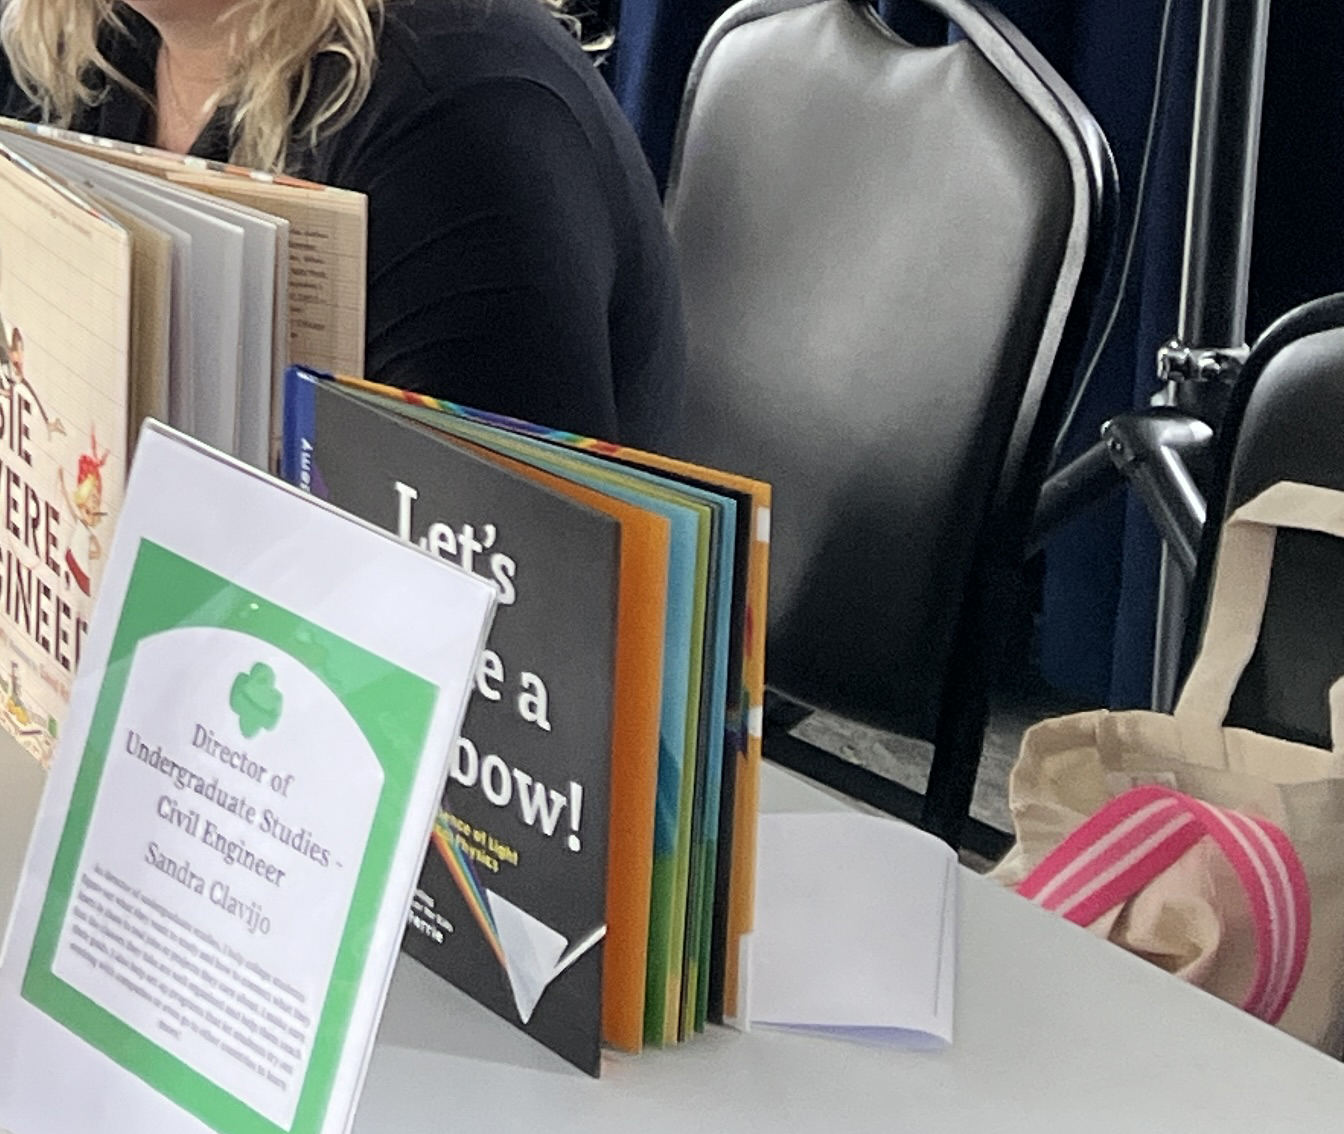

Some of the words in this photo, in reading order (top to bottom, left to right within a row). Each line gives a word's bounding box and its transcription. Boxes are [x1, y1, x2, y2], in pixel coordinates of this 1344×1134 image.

[395, 481, 516, 605] Let's
[518, 671, 552, 733] a
[125, 730, 256, 824] Undergraduate
[259, 808, 331, 868] Studies
[192, 723, 268, 783] Director
[270, 773, 296, 798] of
[144, 840, 205, 896] Sandra
[208, 879, 272, 936] Clavijo
[157, 794, 201, 838] Civil
[202, 819, 287, 888] Engineer
